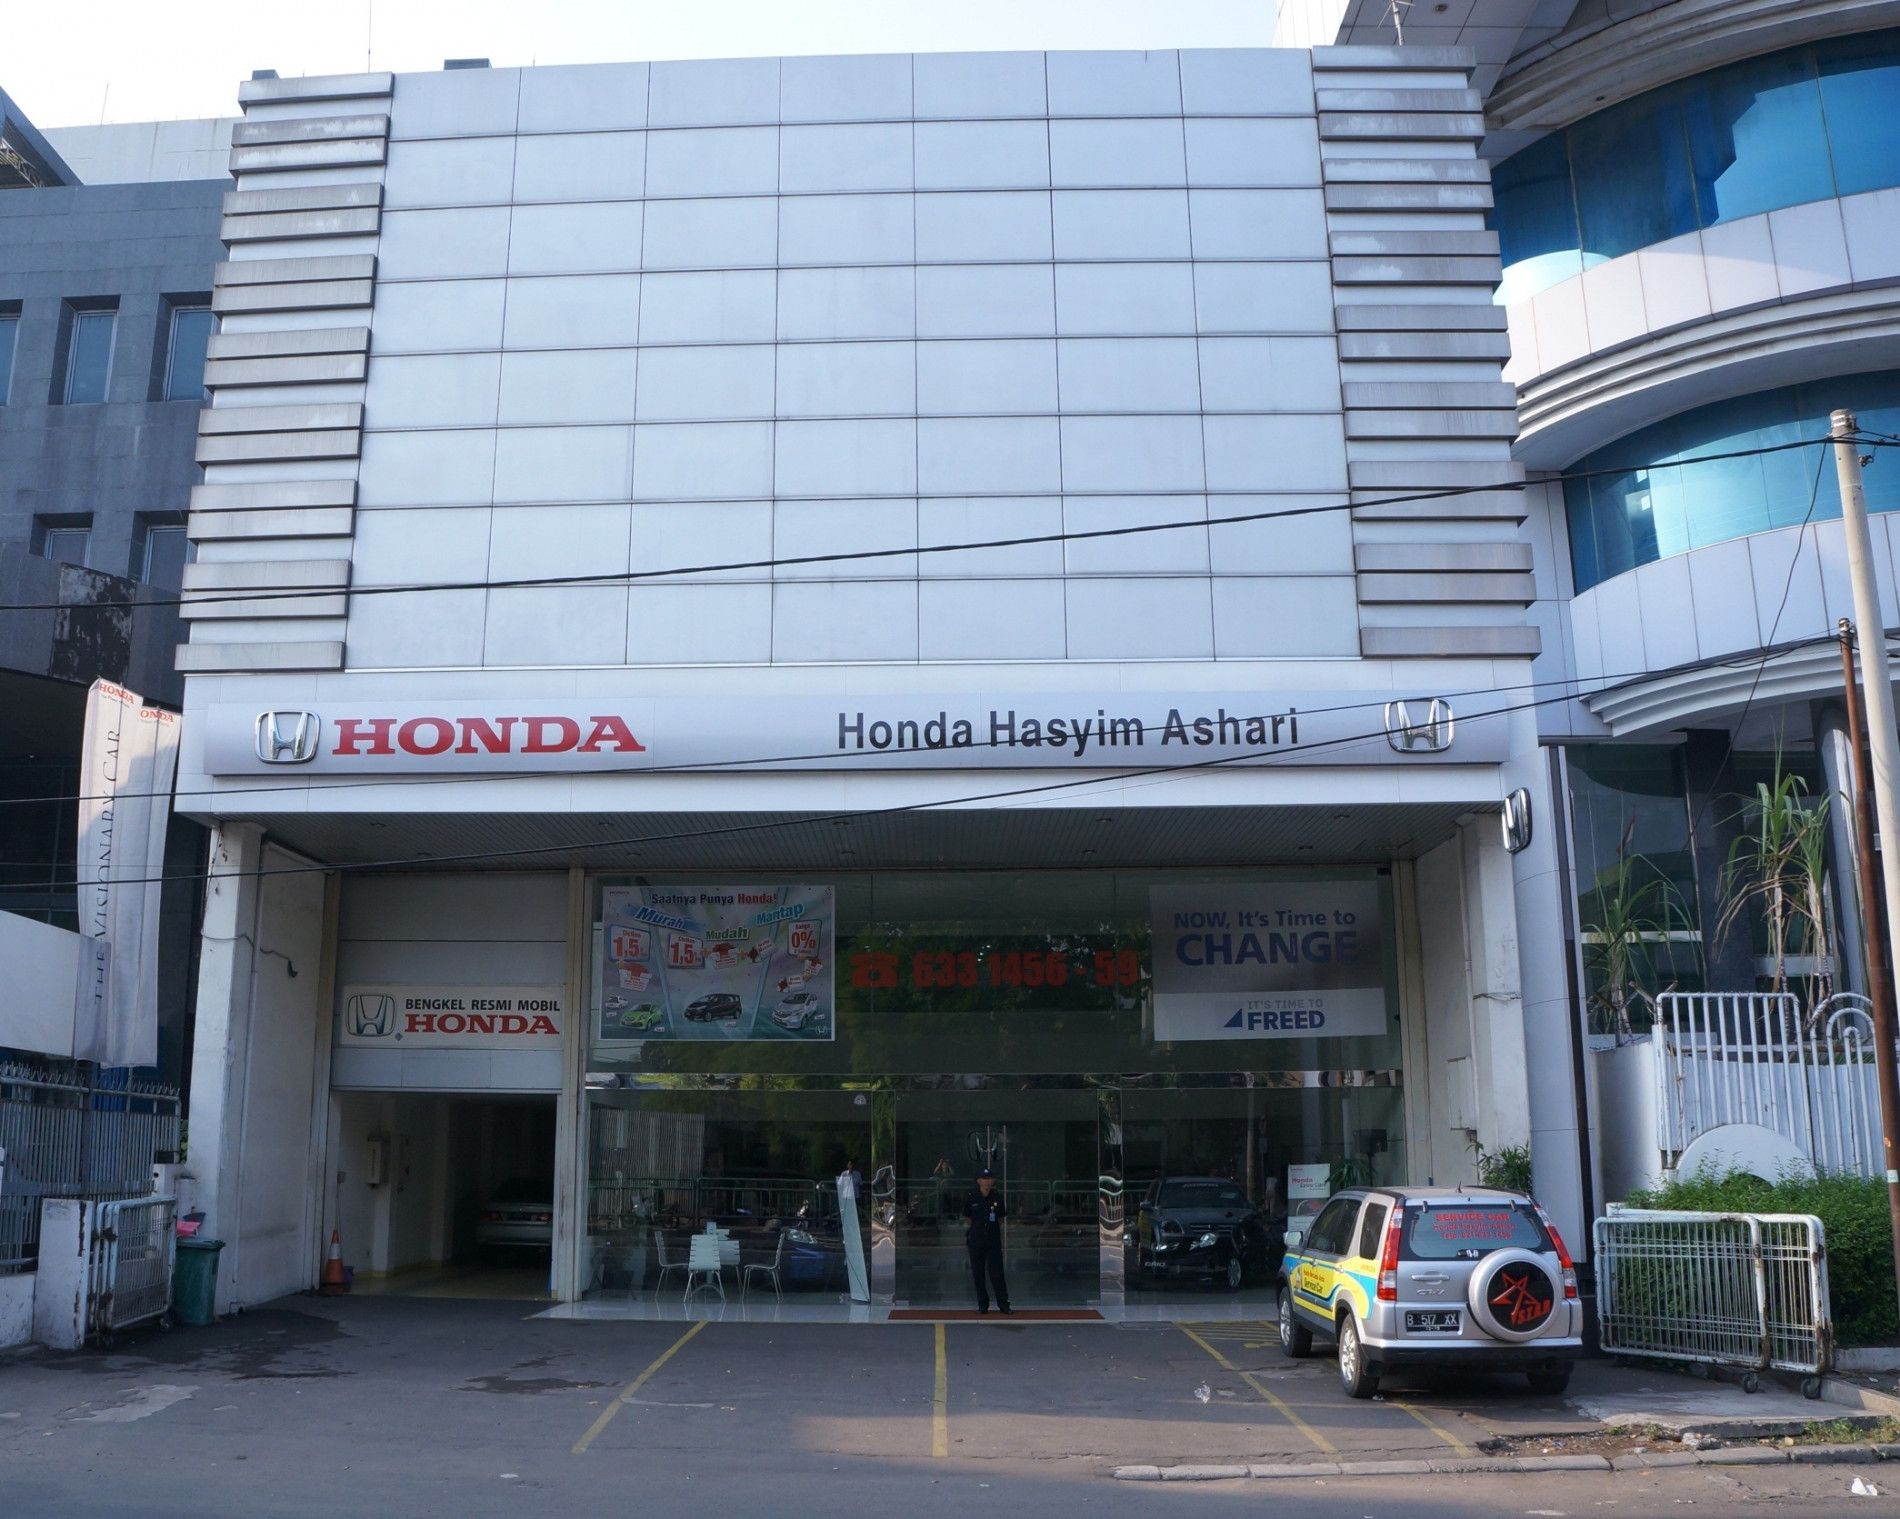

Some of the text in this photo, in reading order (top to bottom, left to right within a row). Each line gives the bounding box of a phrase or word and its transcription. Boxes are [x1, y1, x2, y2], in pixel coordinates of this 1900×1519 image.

[99, 683, 135, 705] HONDA
[140, 708, 175, 722] ONDA
[332, 716, 646, 755] HONDA
[838, 707, 1298, 757] Honda Hasyim Ashari
[103, 729, 120, 782] CAR
[652, 893, 777, 905] Saatnya Punya Honda!
[635, 906, 685, 929] Murah
[756, 904, 804, 924] Mantap
[1174, 909, 1356, 930] NOW, It's Time to
[706, 927, 748, 940] Mudah
[791, 930, 817, 949] 0%
[613, 937, 640, 958] 1,5
[671, 942, 695, 965] 1,5
[1175, 931, 1361, 966] CHANGE
[911, 951, 978, 988] 633
[986, 951, 1069, 988] 1456
[1094, 951, 1139, 987] 59
[405, 998, 561, 1012] BENGKEL RESMI MOBIL
[1248, 999, 1324, 1010] IT'S TIME TO
[404, 1013, 561, 1035] HONDA
[1248, 1010, 1326, 1031] FREED
[1407, 1313, 1457, 1326] B 517 XX
